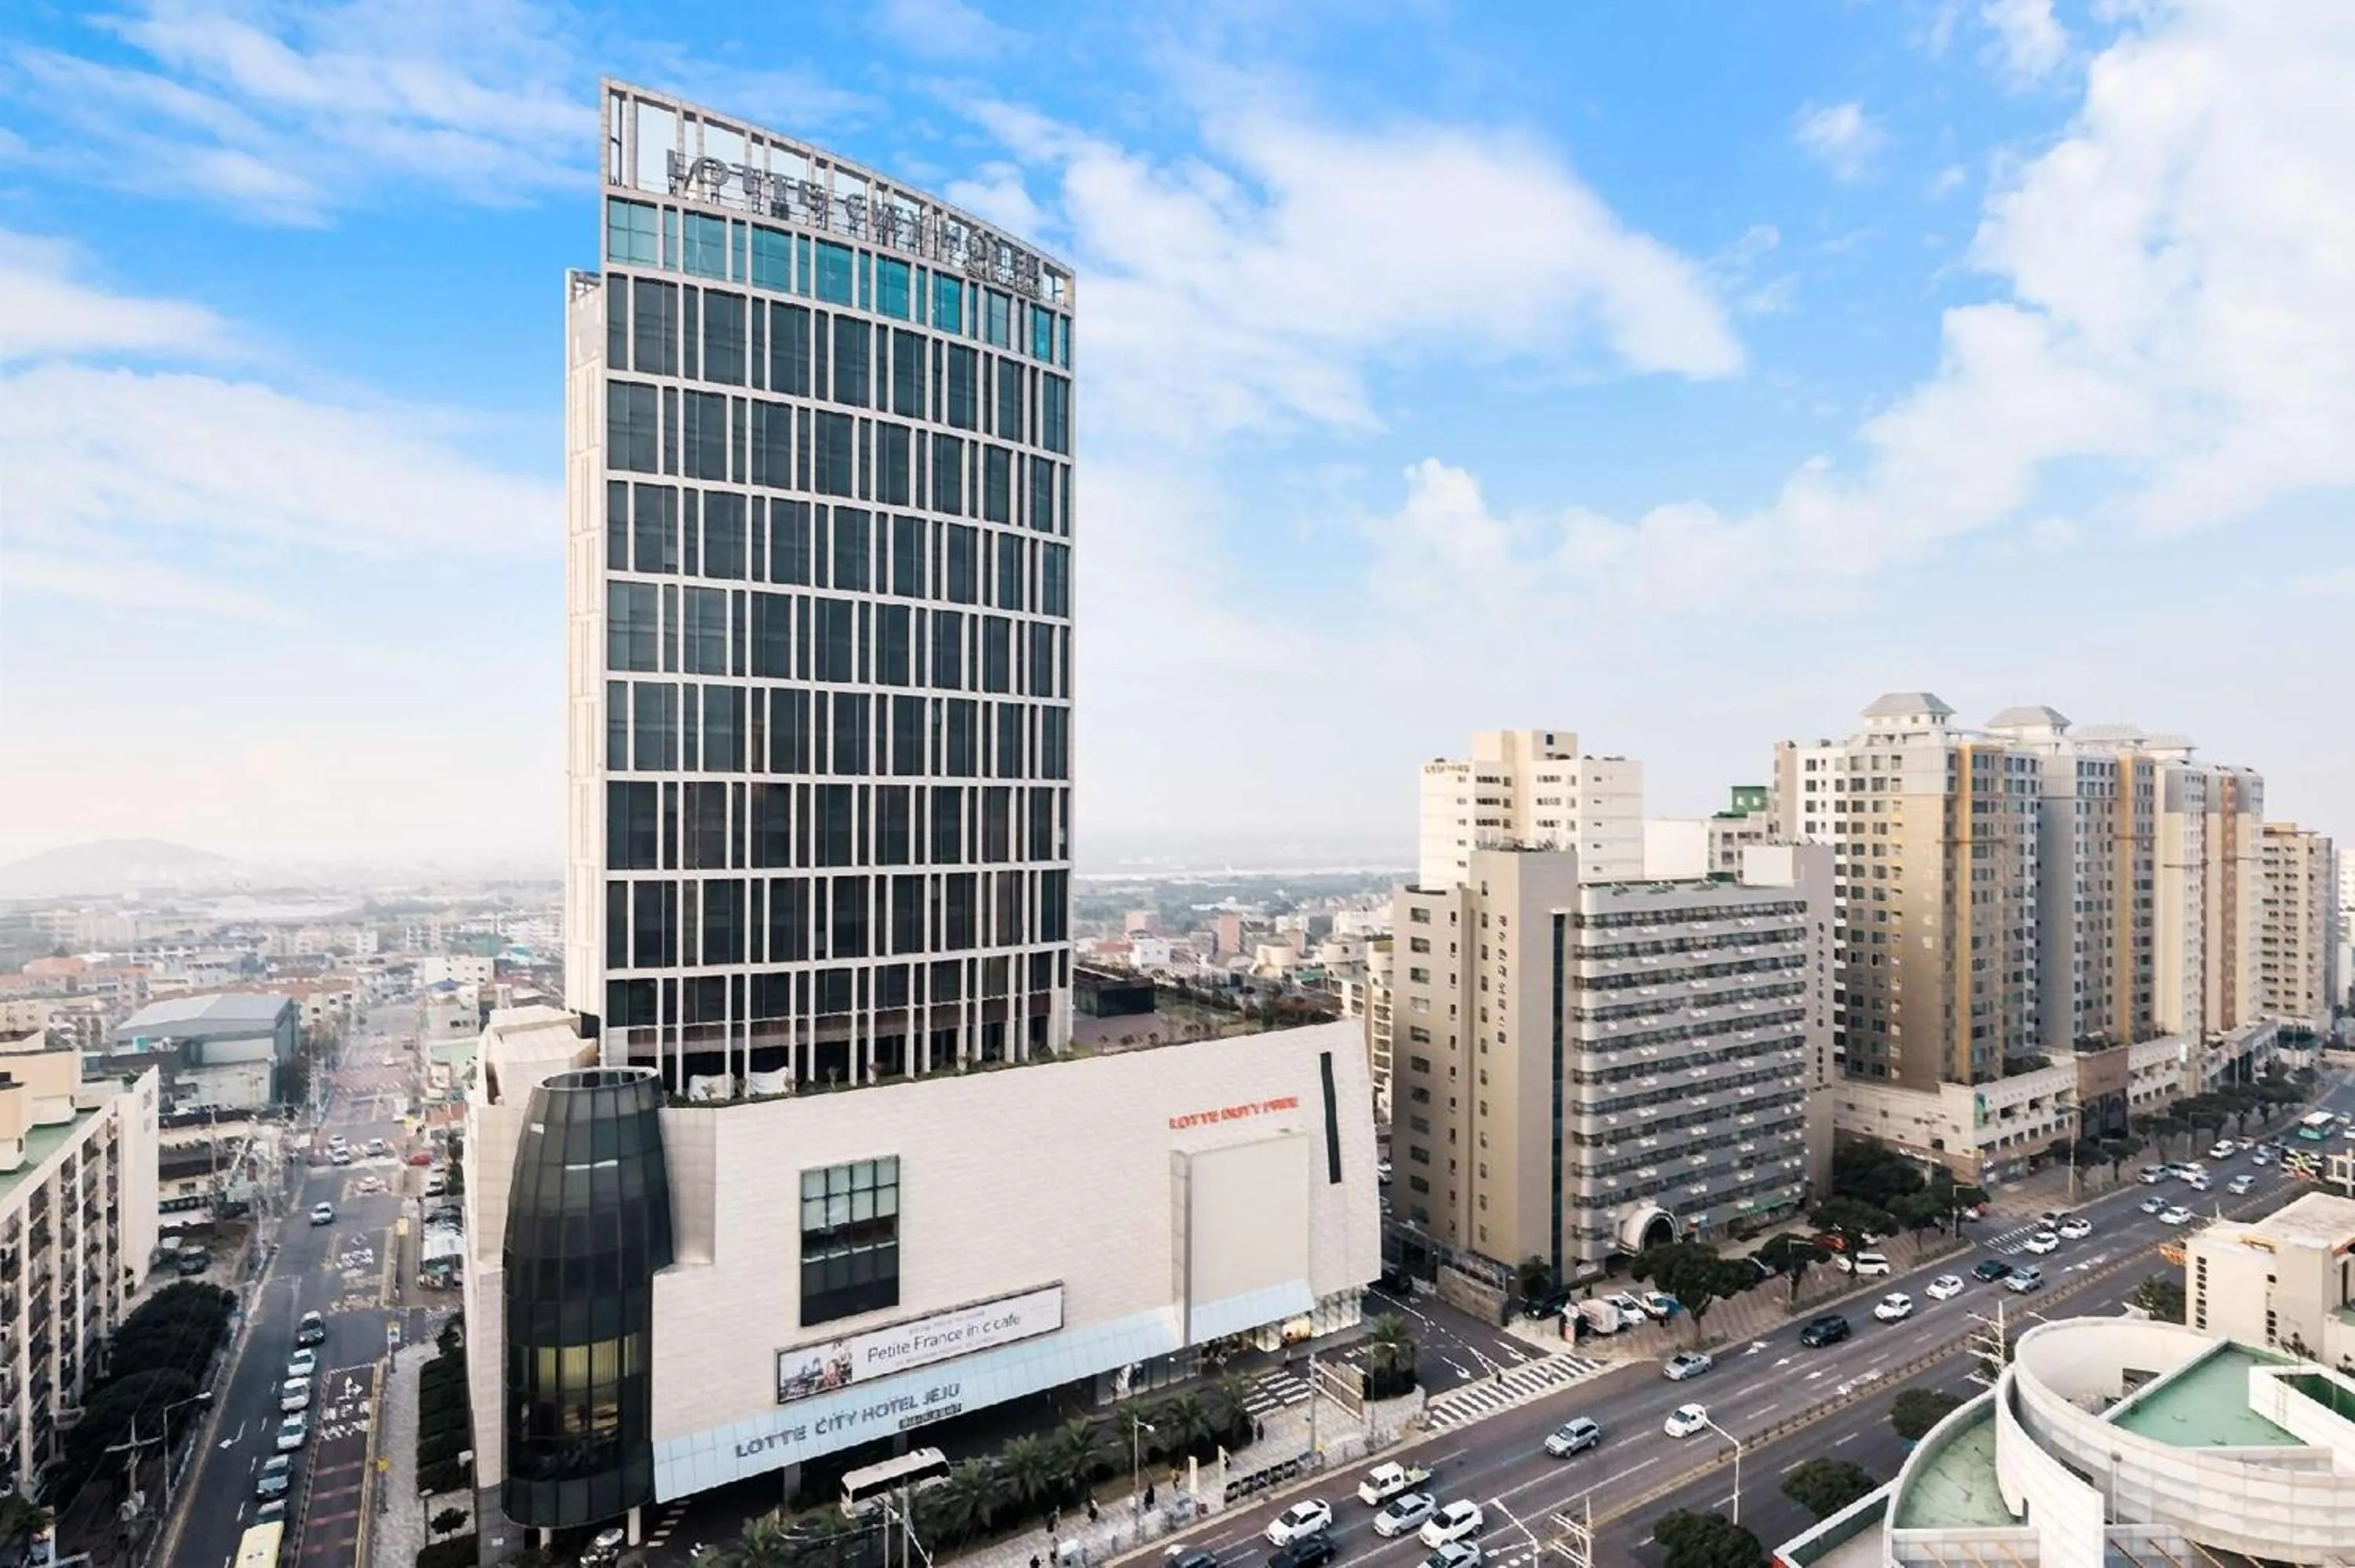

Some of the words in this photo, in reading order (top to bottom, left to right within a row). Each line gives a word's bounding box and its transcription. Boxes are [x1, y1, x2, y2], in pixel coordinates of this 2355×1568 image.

[666, 149, 824, 211] LOTTE
[1169, 1110, 1218, 1129] LOTTE
[867, 1342, 910, 1362] Petite
[915, 1329, 963, 1351] France
[966, 1323, 979, 1337] in
[735, 1424, 807, 1458] LOTTE
[815, 1409, 859, 1435] CITY
[861, 1395, 918, 1423] HOTEL
[922, 1382, 961, 1406] JEJU
